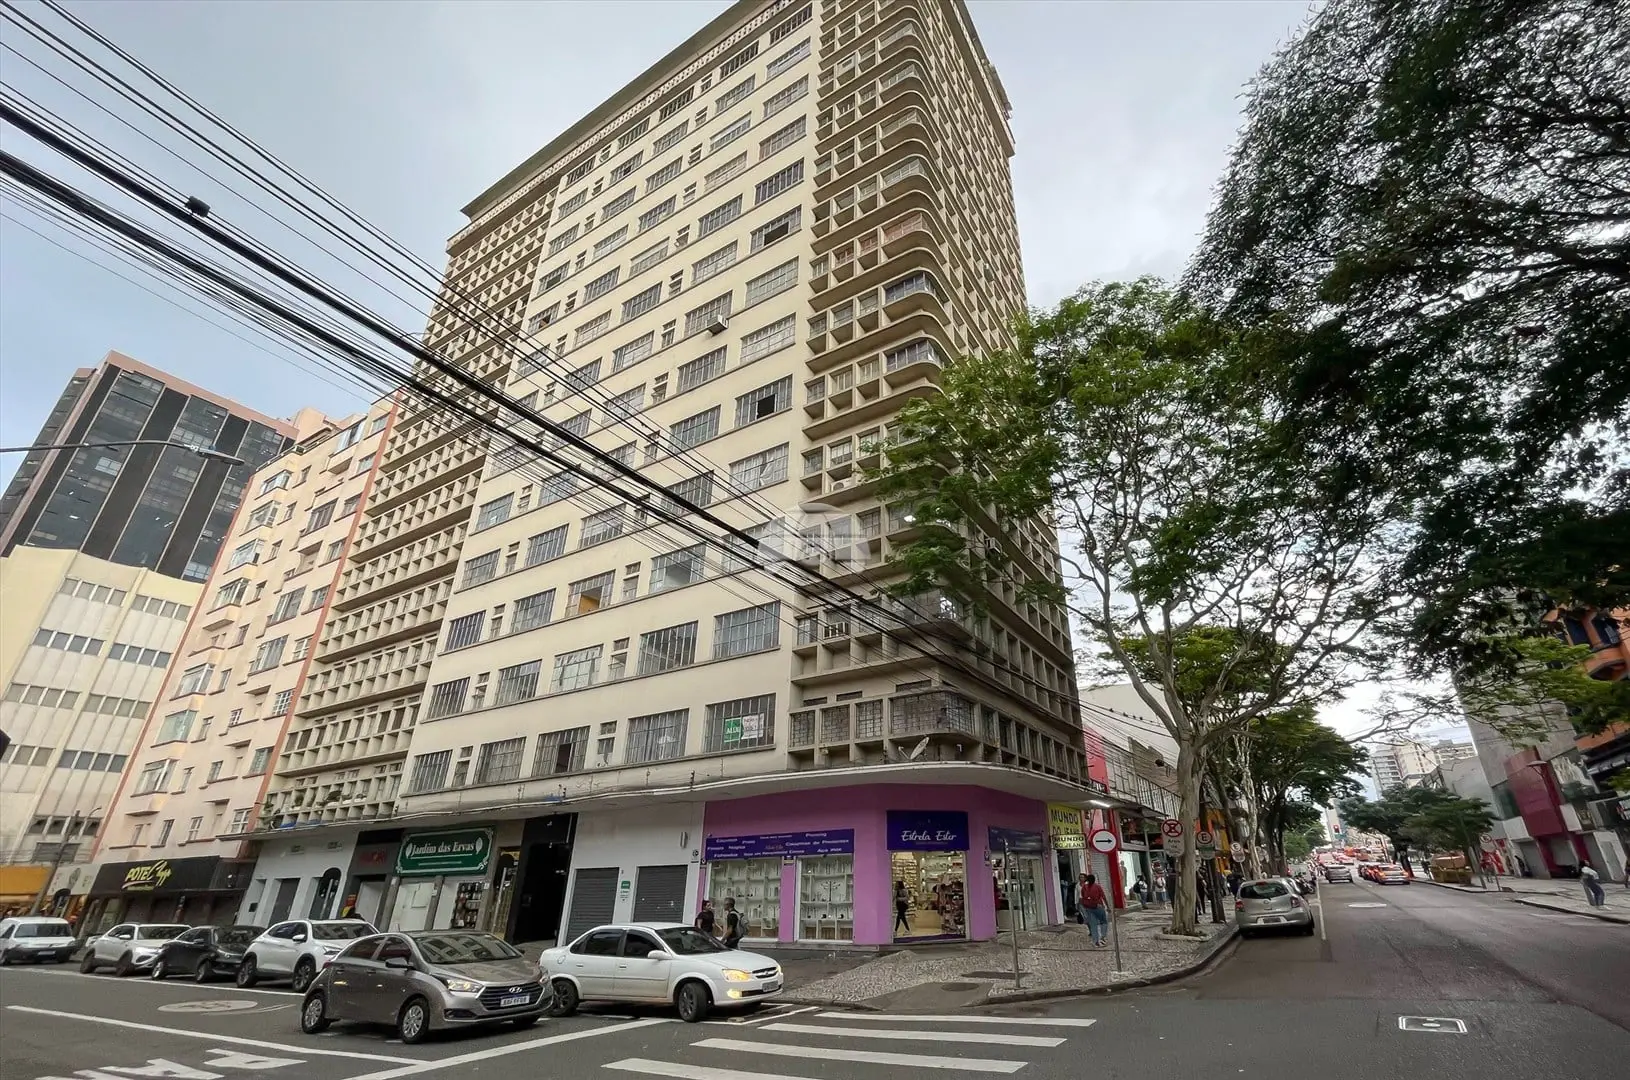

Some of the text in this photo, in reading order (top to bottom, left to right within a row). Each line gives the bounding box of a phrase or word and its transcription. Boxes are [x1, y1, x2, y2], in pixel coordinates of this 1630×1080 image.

[1051, 809, 1078, 825] MUNDO
[935, 830, 957, 841] Ester
[411, 841, 475, 857] Jardim das Ervas
